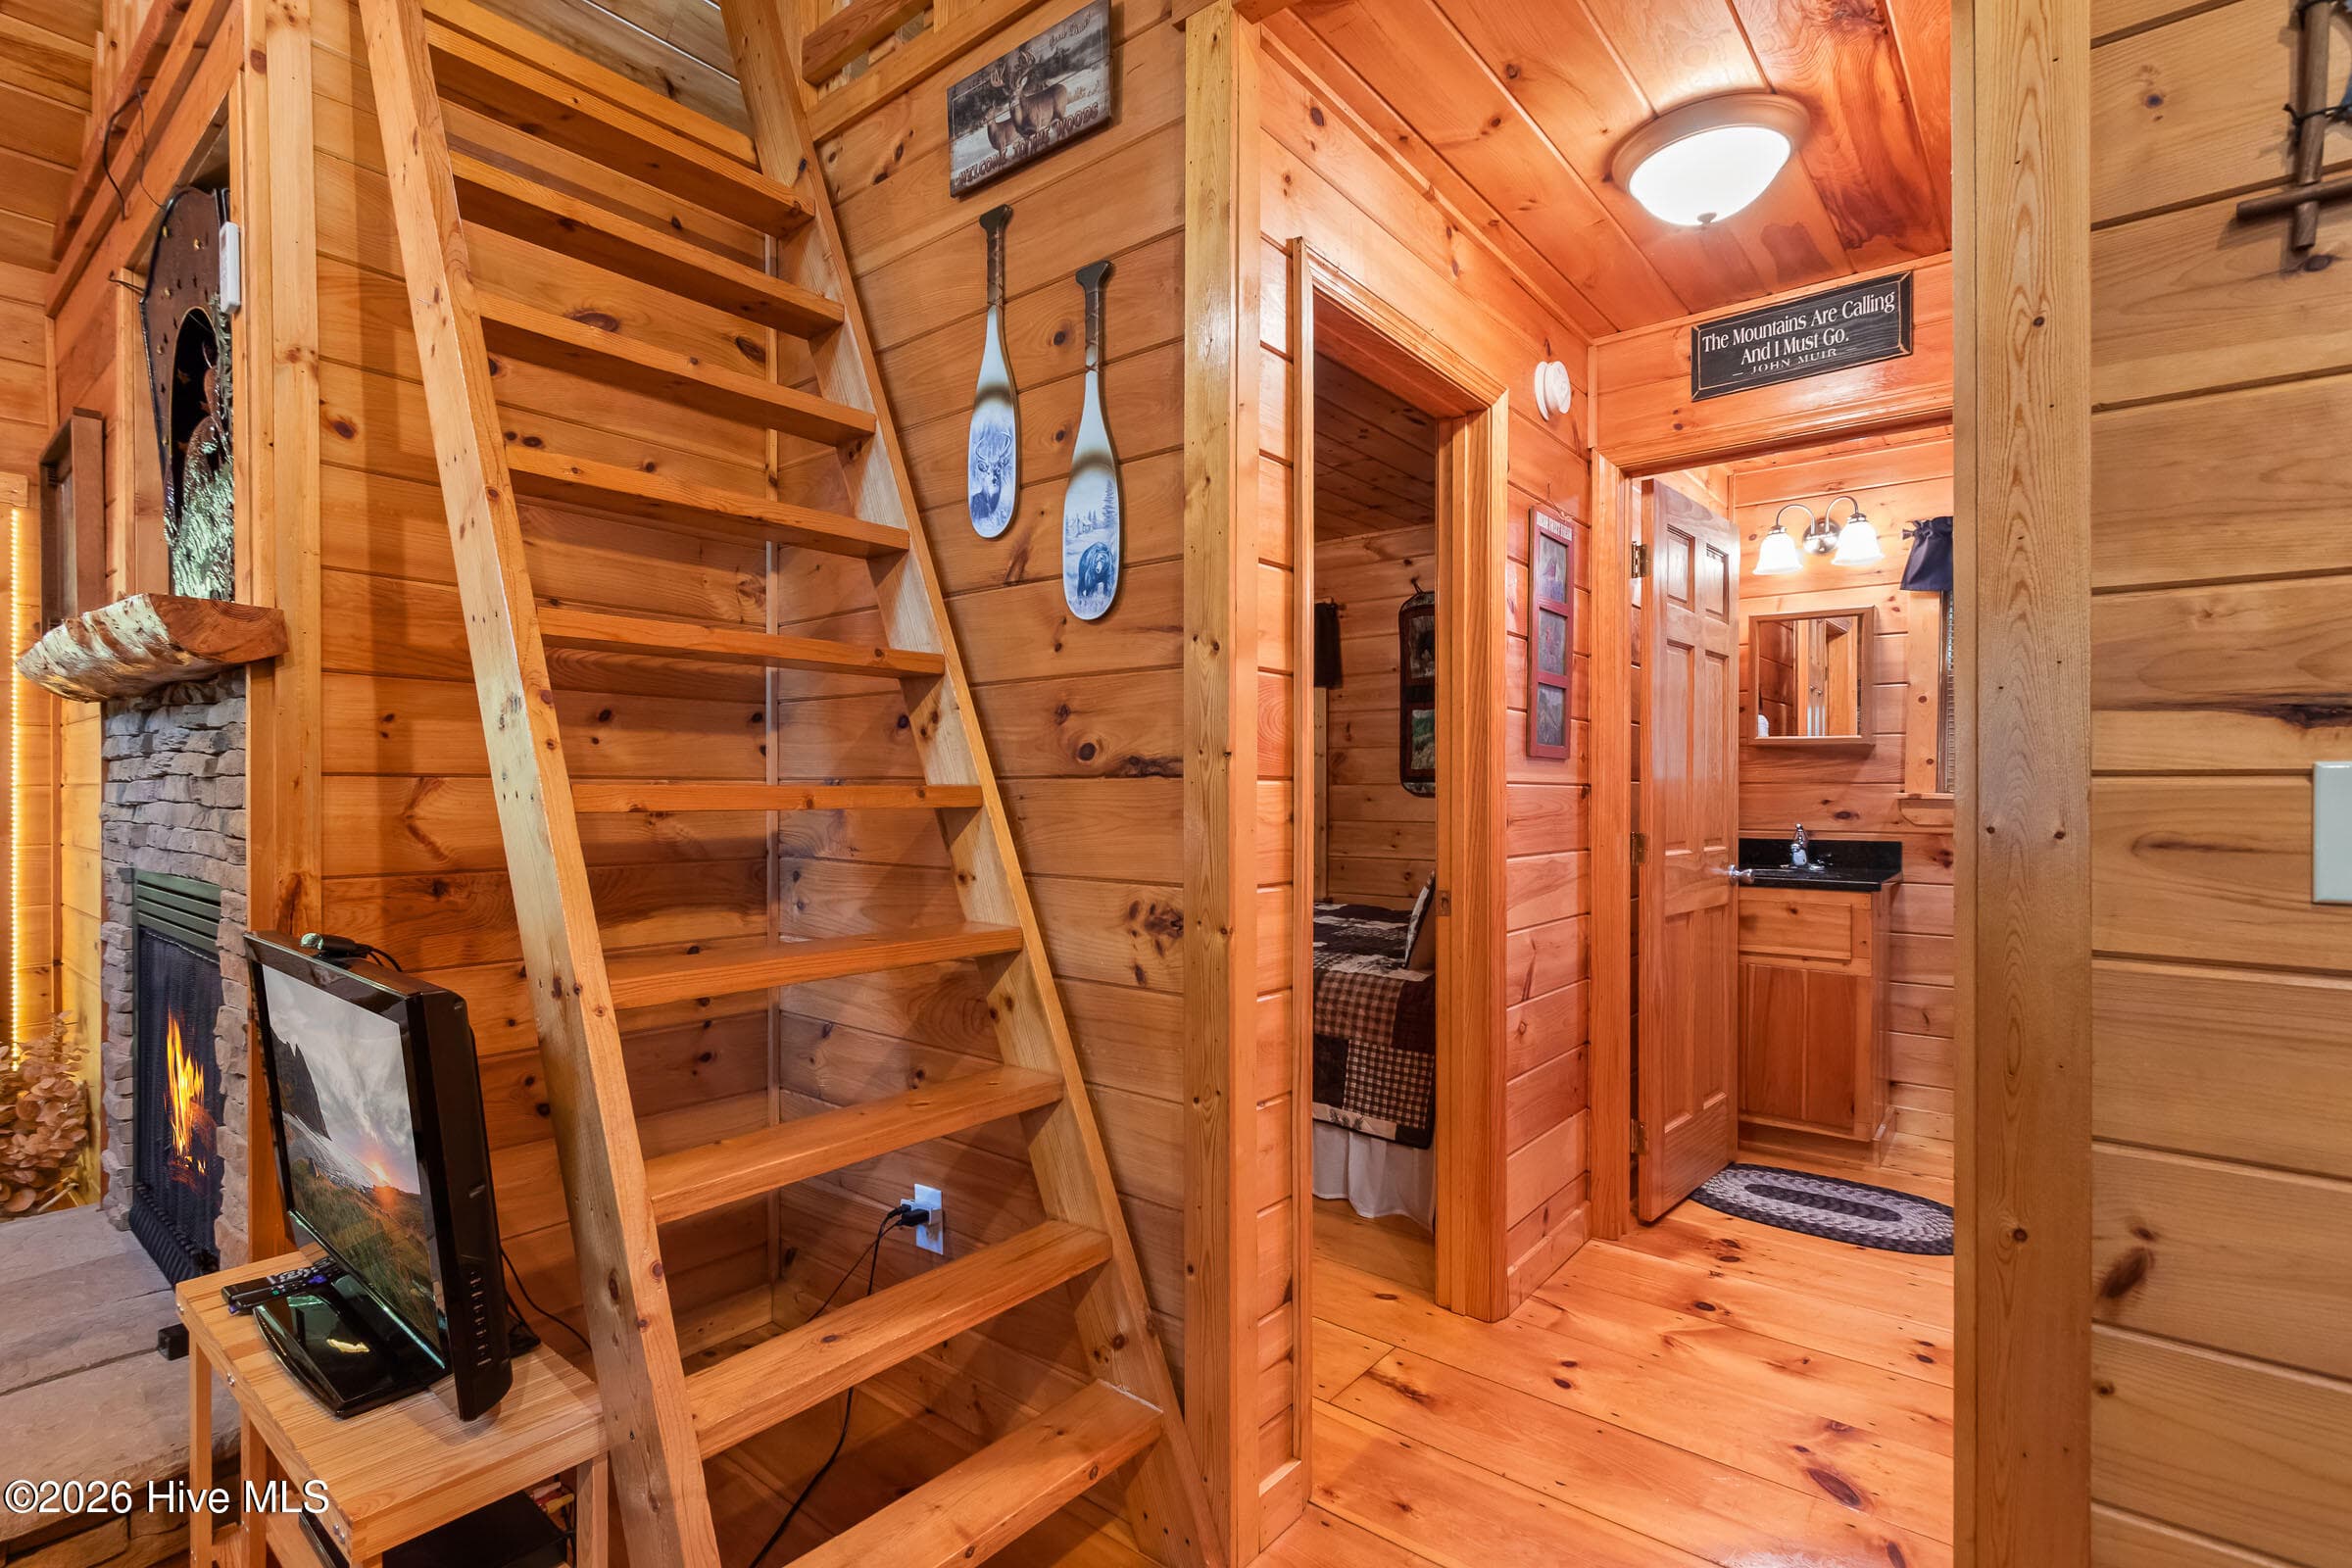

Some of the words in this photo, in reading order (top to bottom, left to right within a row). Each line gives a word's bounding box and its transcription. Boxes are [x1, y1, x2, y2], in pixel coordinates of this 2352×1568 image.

[1013, 138, 1027, 157] TO
[1028, 125, 1052, 154] THE
[1056, 102, 1099, 140] WOODS
[1701, 332, 1730, 353] The
[1733, 315, 1807, 346] Mountains
[1810, 306, 1838, 327] Are
[1841, 291, 1896, 319] Calling
[1740, 341, 1771, 366] And
[1774, 341, 1780, 358] I
[1783, 333, 1819, 355] Must
[1823, 327, 1850, 345] Go.
[1750, 359, 1791, 375] JOHN
[1797, 348, 1838, 365] MUIR
